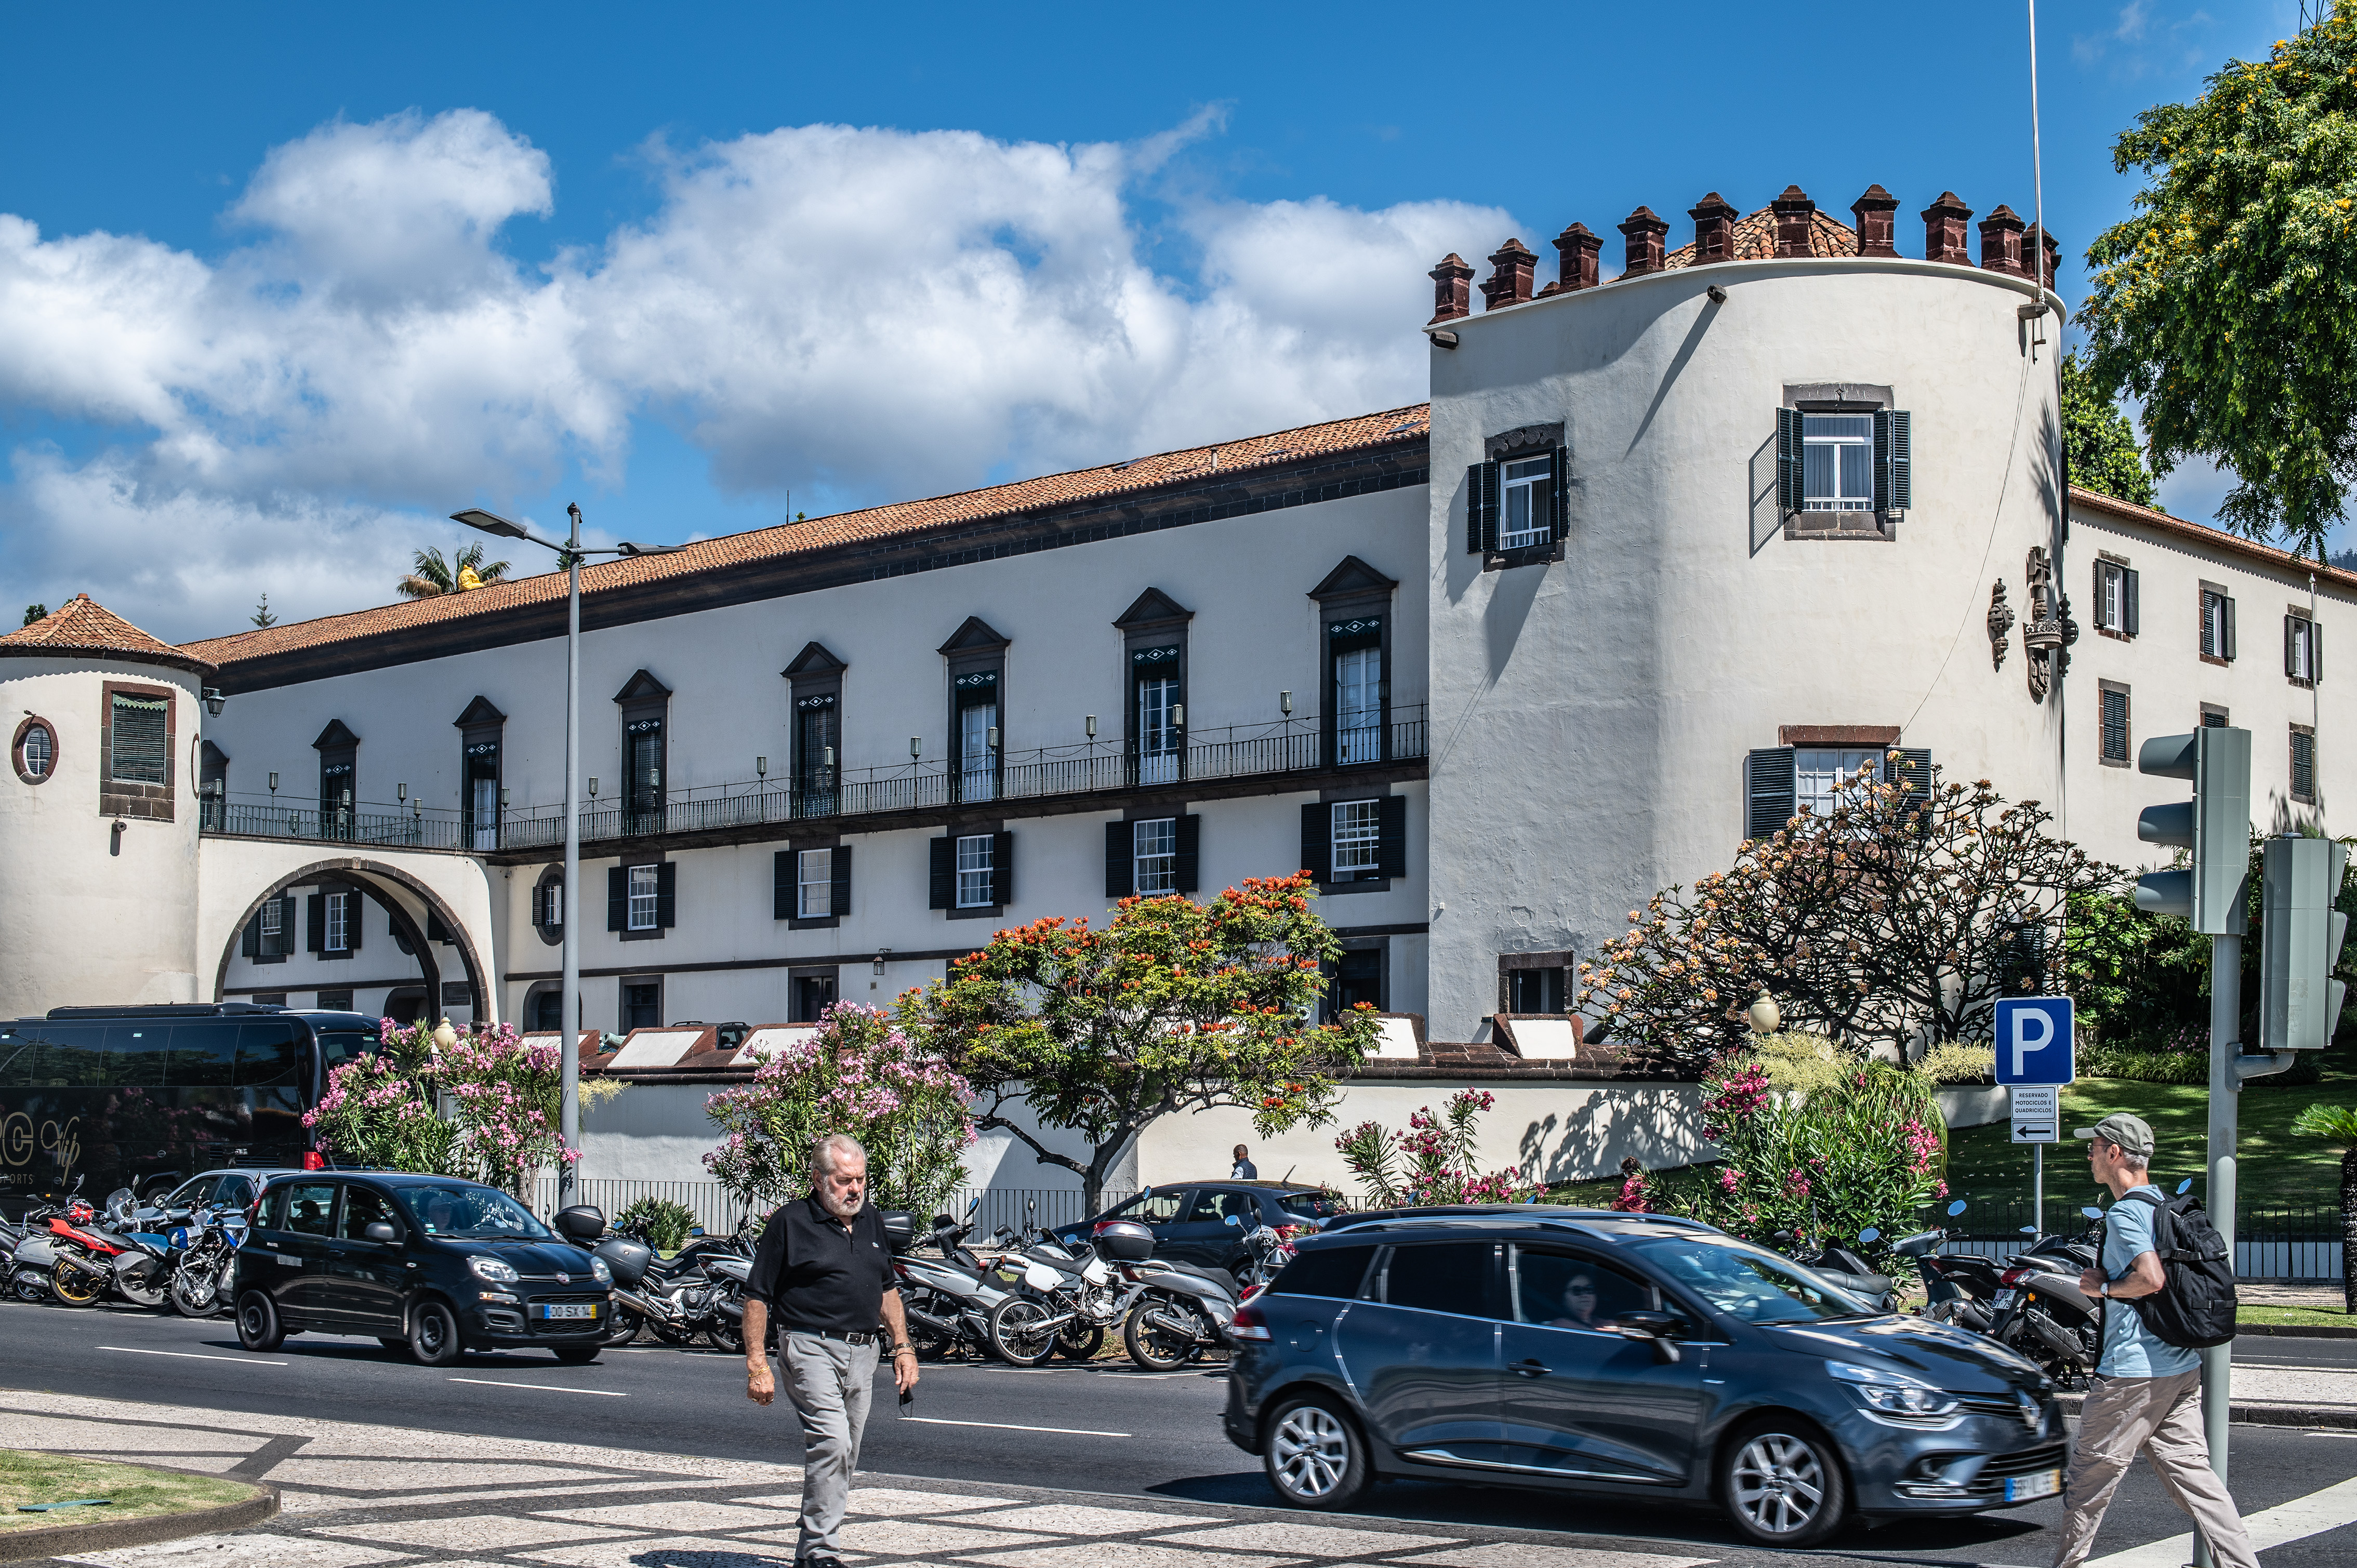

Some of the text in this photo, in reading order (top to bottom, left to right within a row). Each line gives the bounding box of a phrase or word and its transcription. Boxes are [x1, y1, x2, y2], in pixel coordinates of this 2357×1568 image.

[2012, 1008, 2054, 1075] P
[41, 1116, 81, 1187] Vip
[2001, 1290, 2010, 1299] 20
